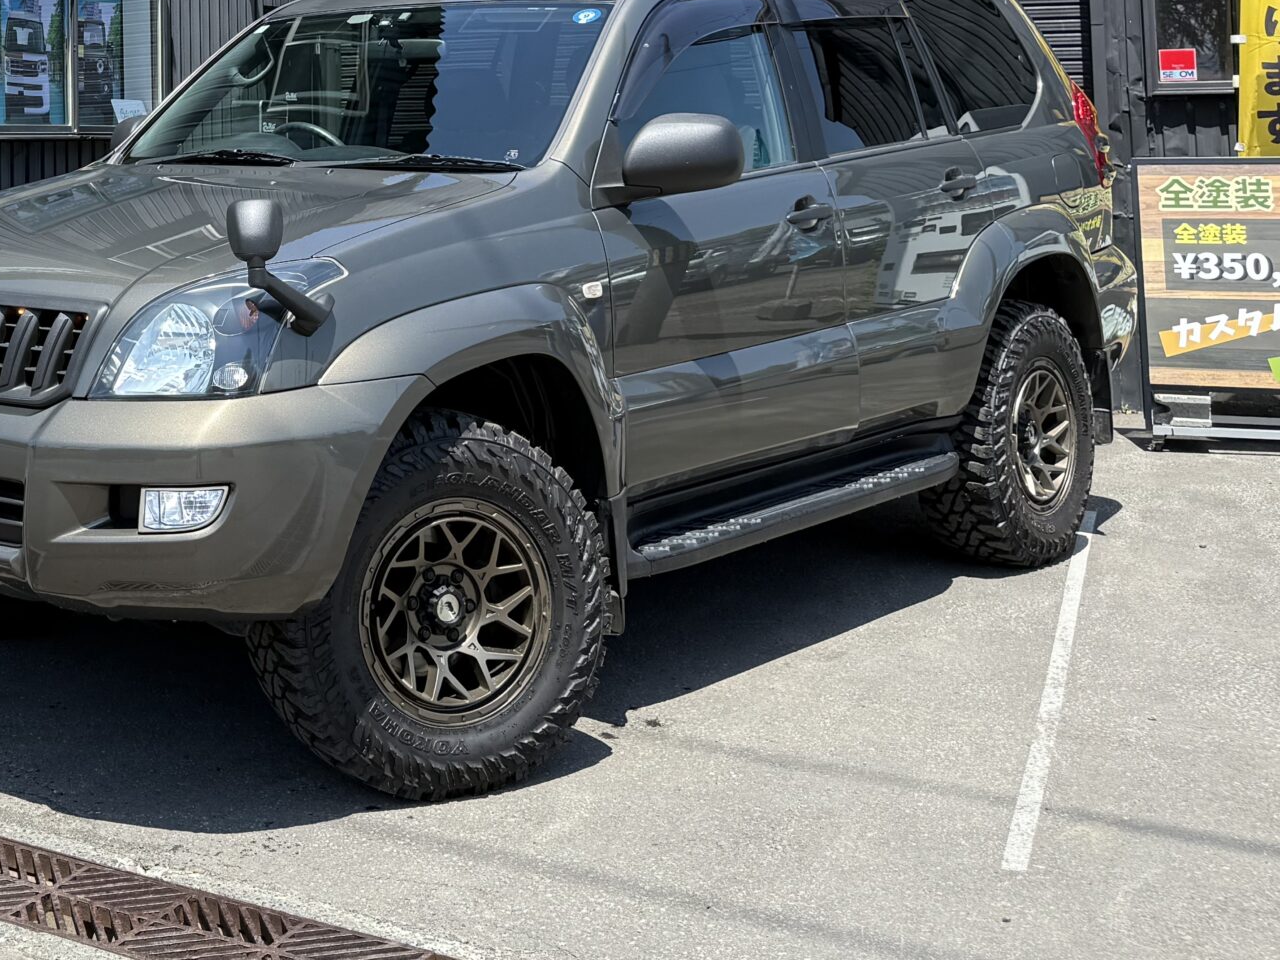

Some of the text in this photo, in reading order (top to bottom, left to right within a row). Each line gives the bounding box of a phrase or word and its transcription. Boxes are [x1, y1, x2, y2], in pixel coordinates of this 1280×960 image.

[1155, 175, 1275, 212] 全塗装
[1173, 222, 1248, 245] 全塗装
[363, 694, 471, 756] YOKOHA
